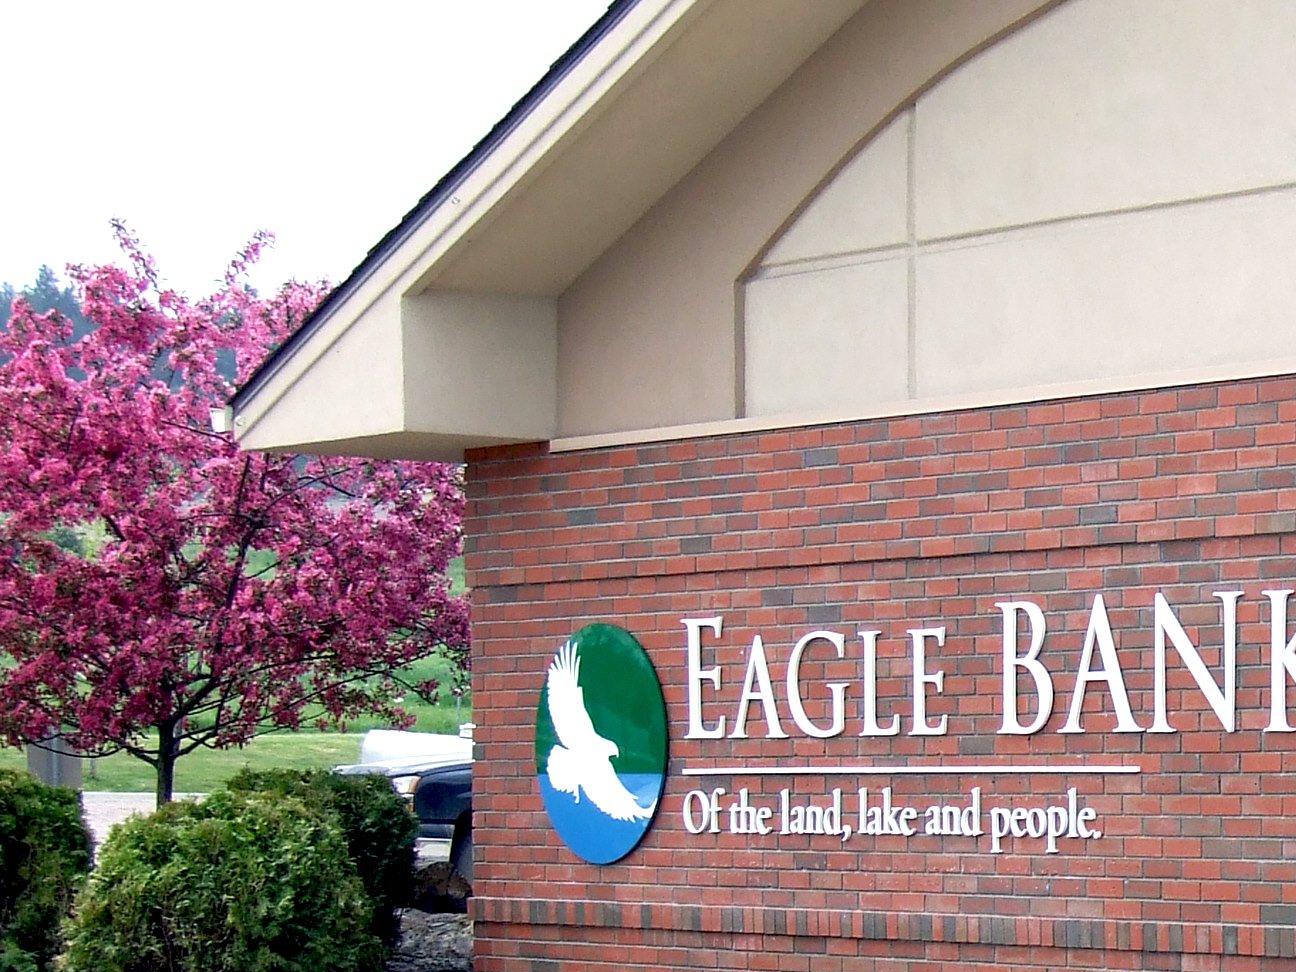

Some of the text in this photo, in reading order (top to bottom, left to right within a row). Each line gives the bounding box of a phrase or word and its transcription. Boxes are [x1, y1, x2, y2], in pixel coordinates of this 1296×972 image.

[680, 616, 949, 739] EAGLE
[683, 787, 1102, 854] Of the land, lake and people.
